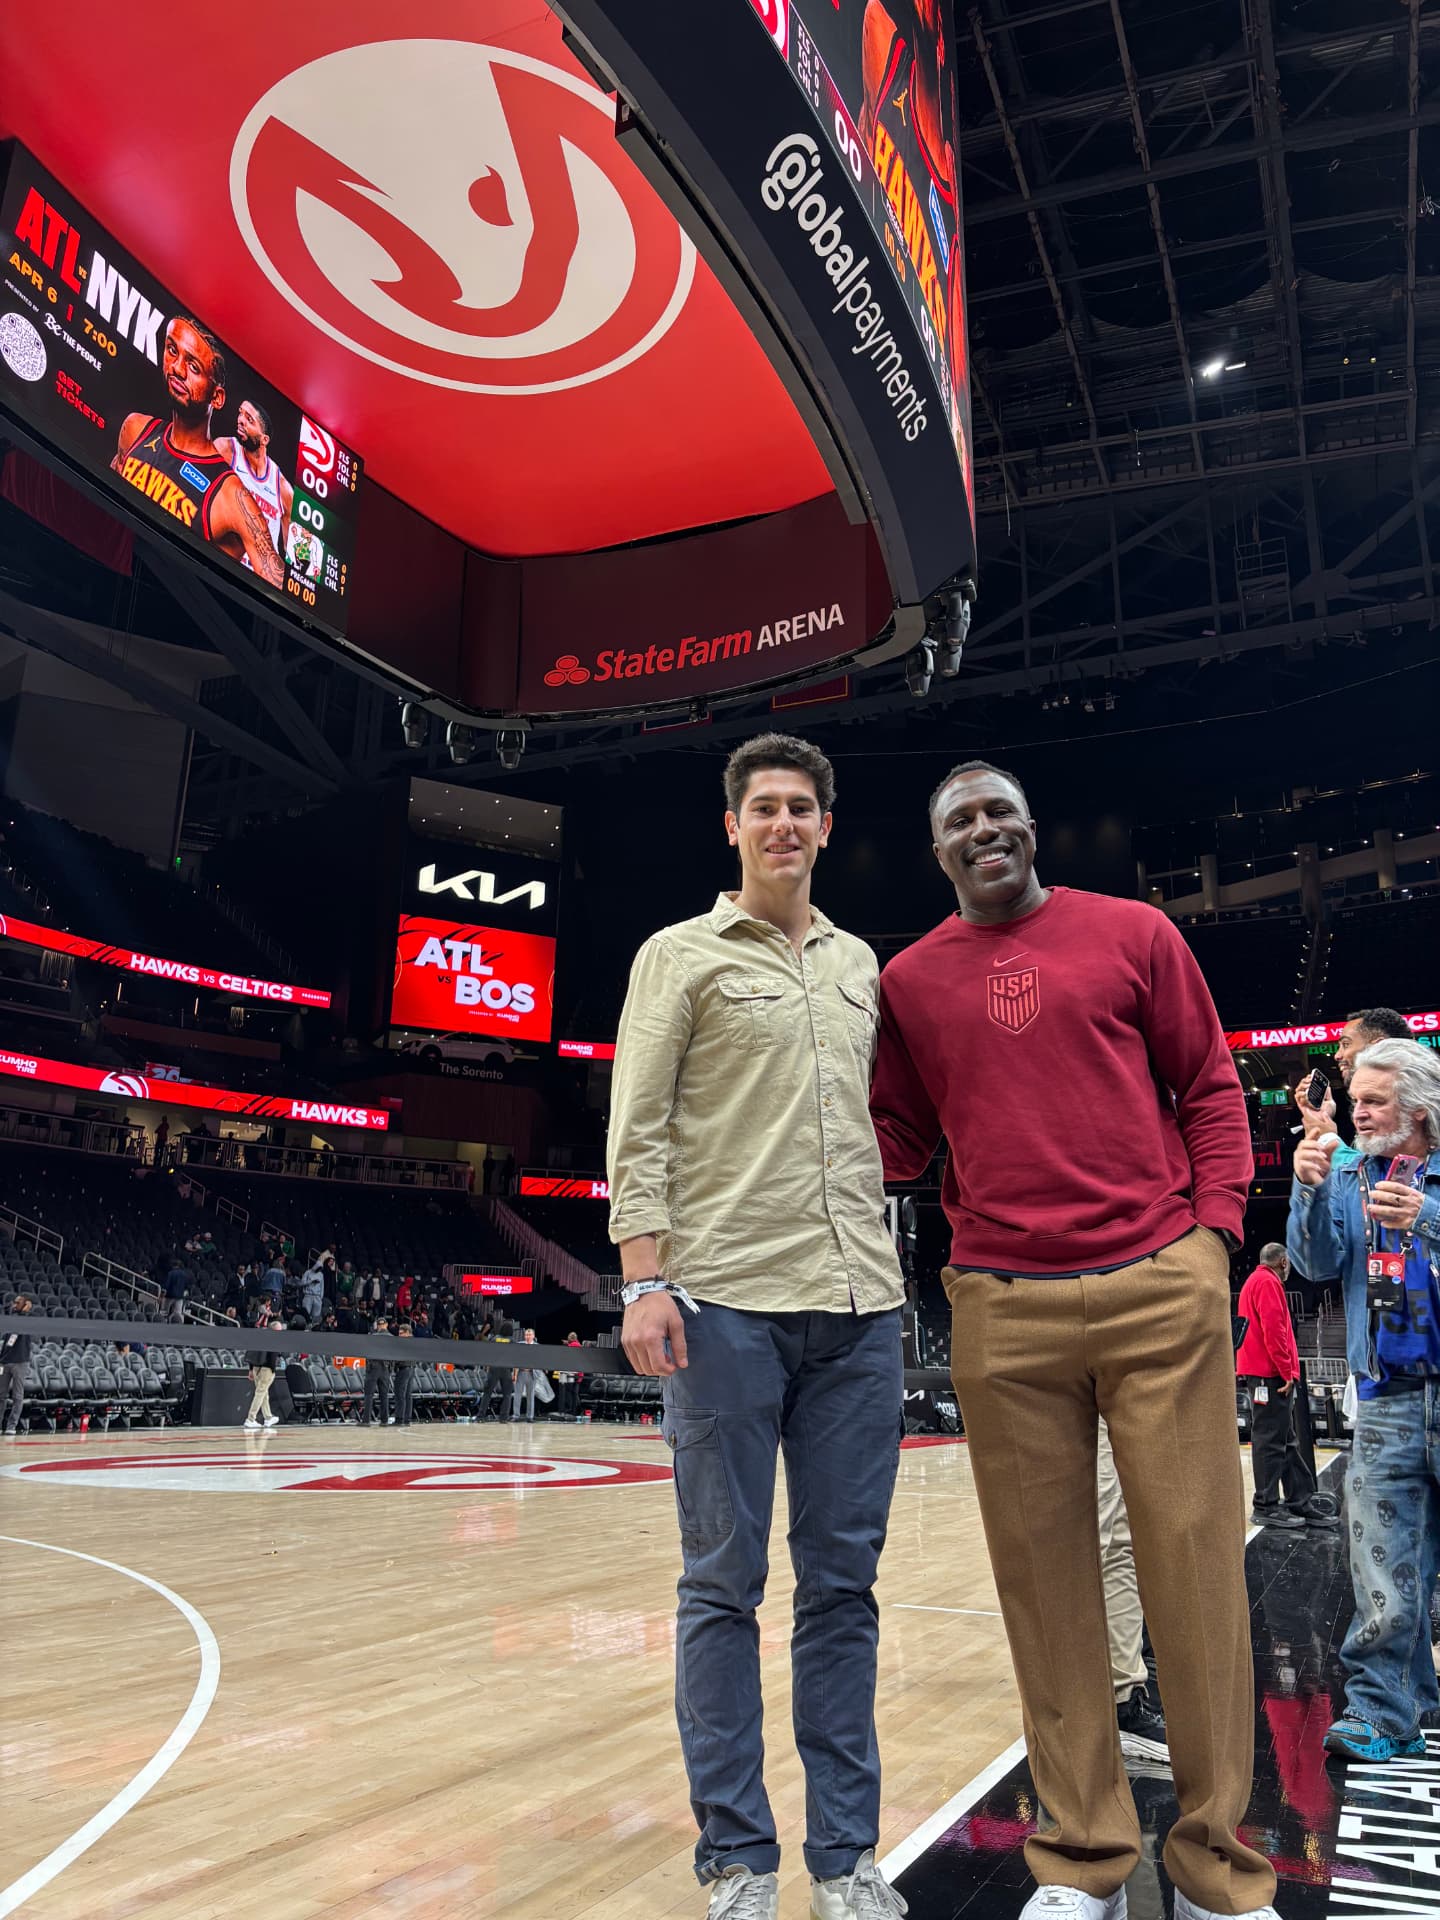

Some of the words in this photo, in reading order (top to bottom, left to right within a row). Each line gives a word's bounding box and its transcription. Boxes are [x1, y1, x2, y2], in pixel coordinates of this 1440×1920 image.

[835, 109, 862, 182] 00
[15, 186, 82, 295] ATL
[9, 252, 44, 292] APR
[47, 286, 58, 304] 6
[85, 250, 165, 367] NYK
[82, 317, 117, 357] 7:00
[920, 304, 936, 362] 00
[62, 330, 77, 350] THE
[75, 342, 103, 371] PEOPLE
[57, 369, 83, 395] GET
[55, 380, 106, 429] TICKETS
[337, 460, 350, 477] TOL
[338, 450, 350, 466] FLS
[122, 456, 199, 528] HAWKS
[302, 468, 328, 499] 00
[336, 472, 349, 488] CHL
[298, 500, 324, 531] 00
[326, 564, 339, 581] TOL
[327, 553, 339, 568] FLS
[324, 576, 338, 592] CHL
[756, 603, 846, 651] ARENA
[414, 936, 494, 976] ATL
[130, 954, 200, 982] HAWKS
[218, 974, 294, 1000] CELTICS
[993, 972, 1033, 998] USA
[454, 974, 536, 1013] BOS
[561, 1043, 594, 1052] KUMHO
[1251, 1026, 1328, 1047] HAWKS
[439, 1062, 460, 1075] The
[462, 1065, 504, 1080] Sorento
[291, 1101, 368, 1126] HAWKS
[481, 1284, 513, 1292] KUMHO
